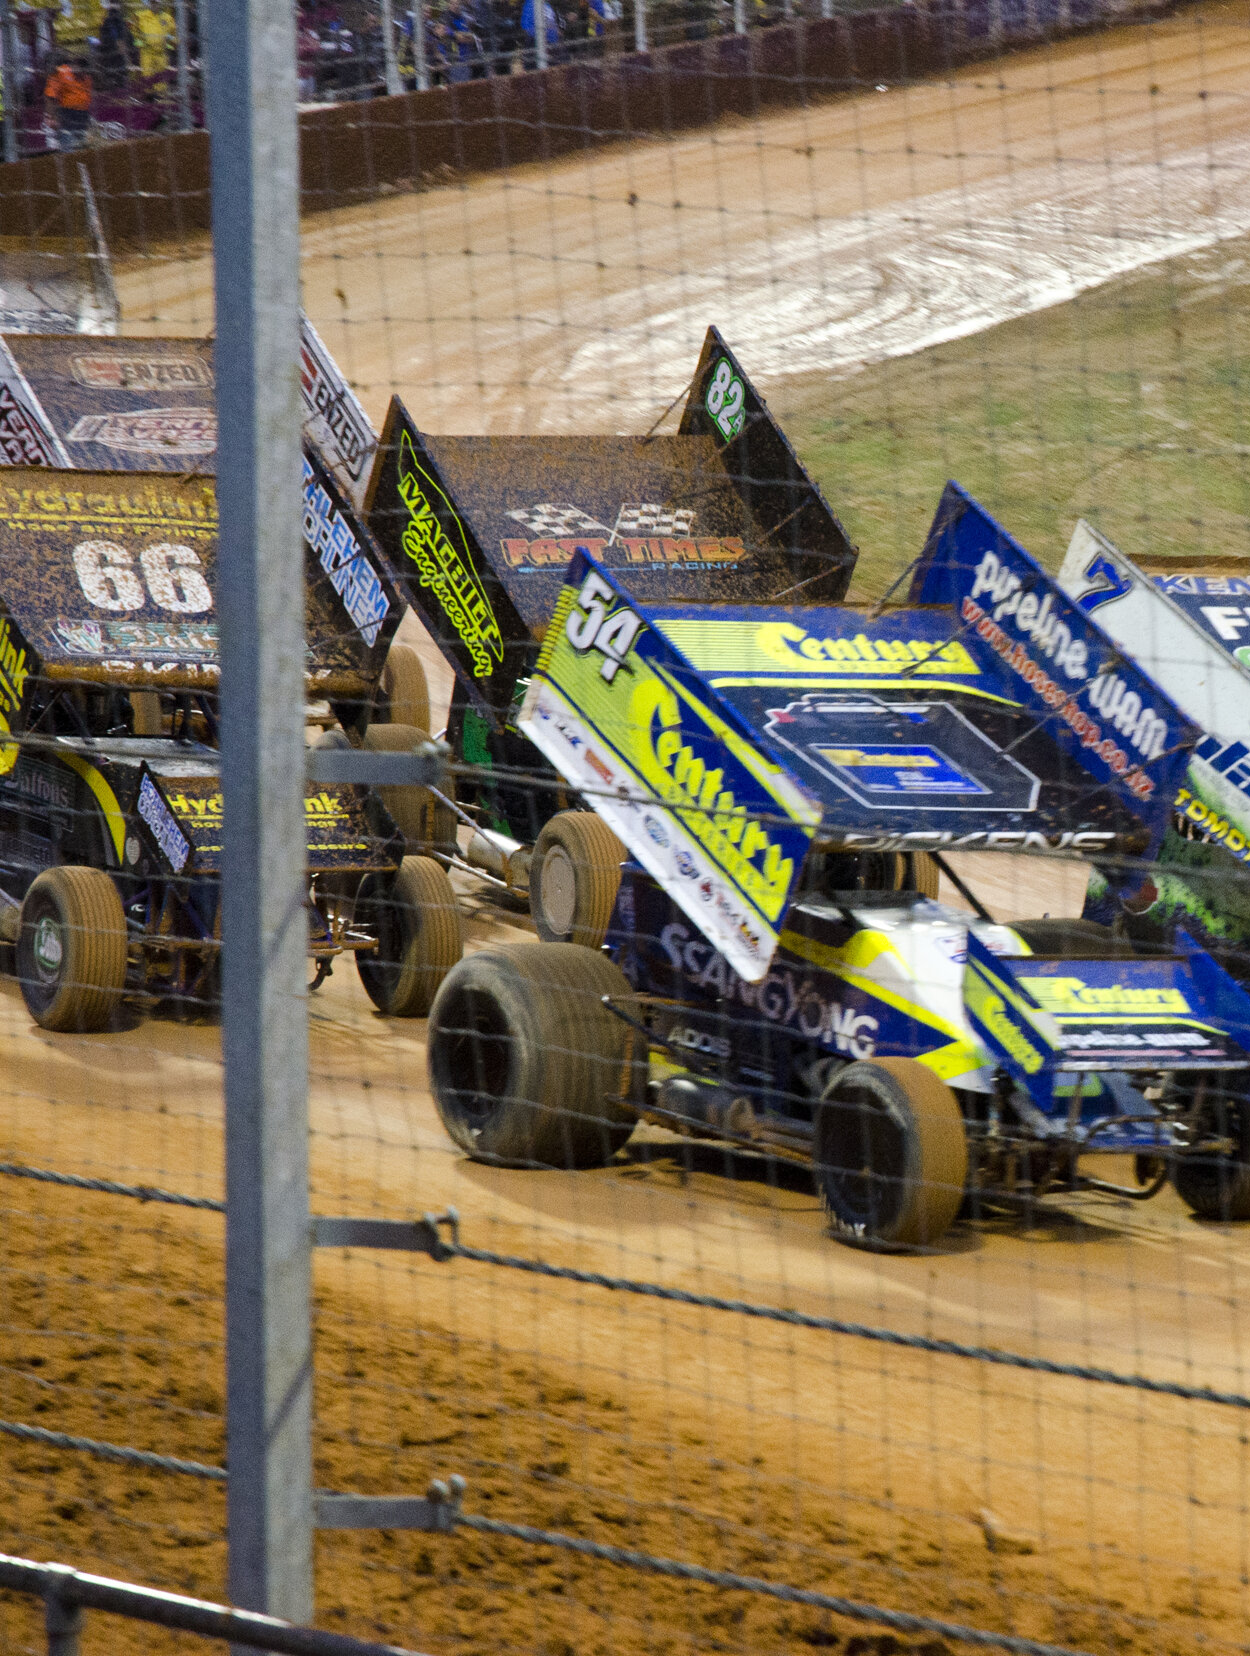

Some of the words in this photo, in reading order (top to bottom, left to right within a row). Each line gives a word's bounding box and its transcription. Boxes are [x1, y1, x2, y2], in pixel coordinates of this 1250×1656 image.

[314, 381, 362, 464] ENZED
[73, 539, 213, 614] 66
[501, 537, 608, 567] FAST
[617, 537, 746, 562] TIMES
[651, 561, 739, 571] RACING
[1080, 555, 1133, 614] 7
[402, 520, 493, 678] Engineering
[566, 568, 645, 686] 54
[757, 621, 982, 675] Century
[630, 679, 795, 922] Century
